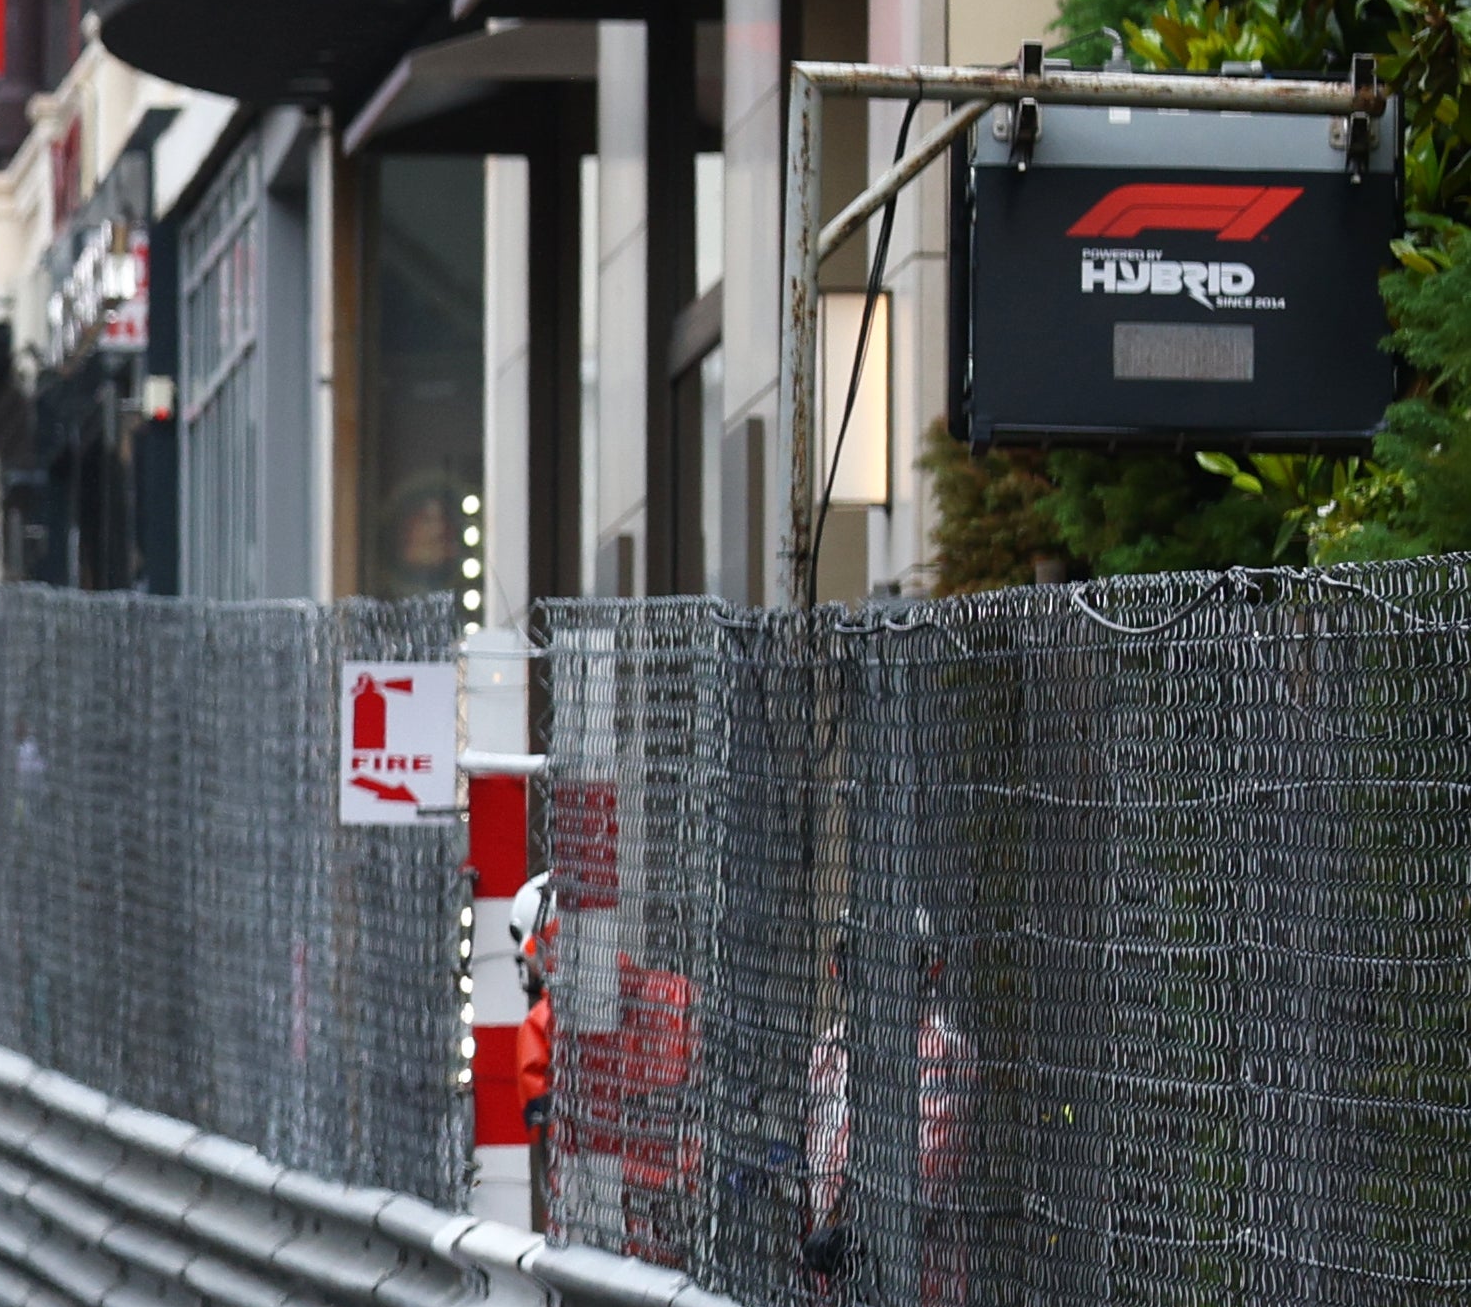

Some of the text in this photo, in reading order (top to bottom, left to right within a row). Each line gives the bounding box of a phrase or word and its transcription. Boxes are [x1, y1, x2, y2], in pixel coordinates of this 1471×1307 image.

[1065, 182, 1305, 242] F1
[1080, 260, 1256, 309] HYBRID
[1215, 296, 1286, 310] SINCE 2014
[351, 754, 432, 772] FIRE
